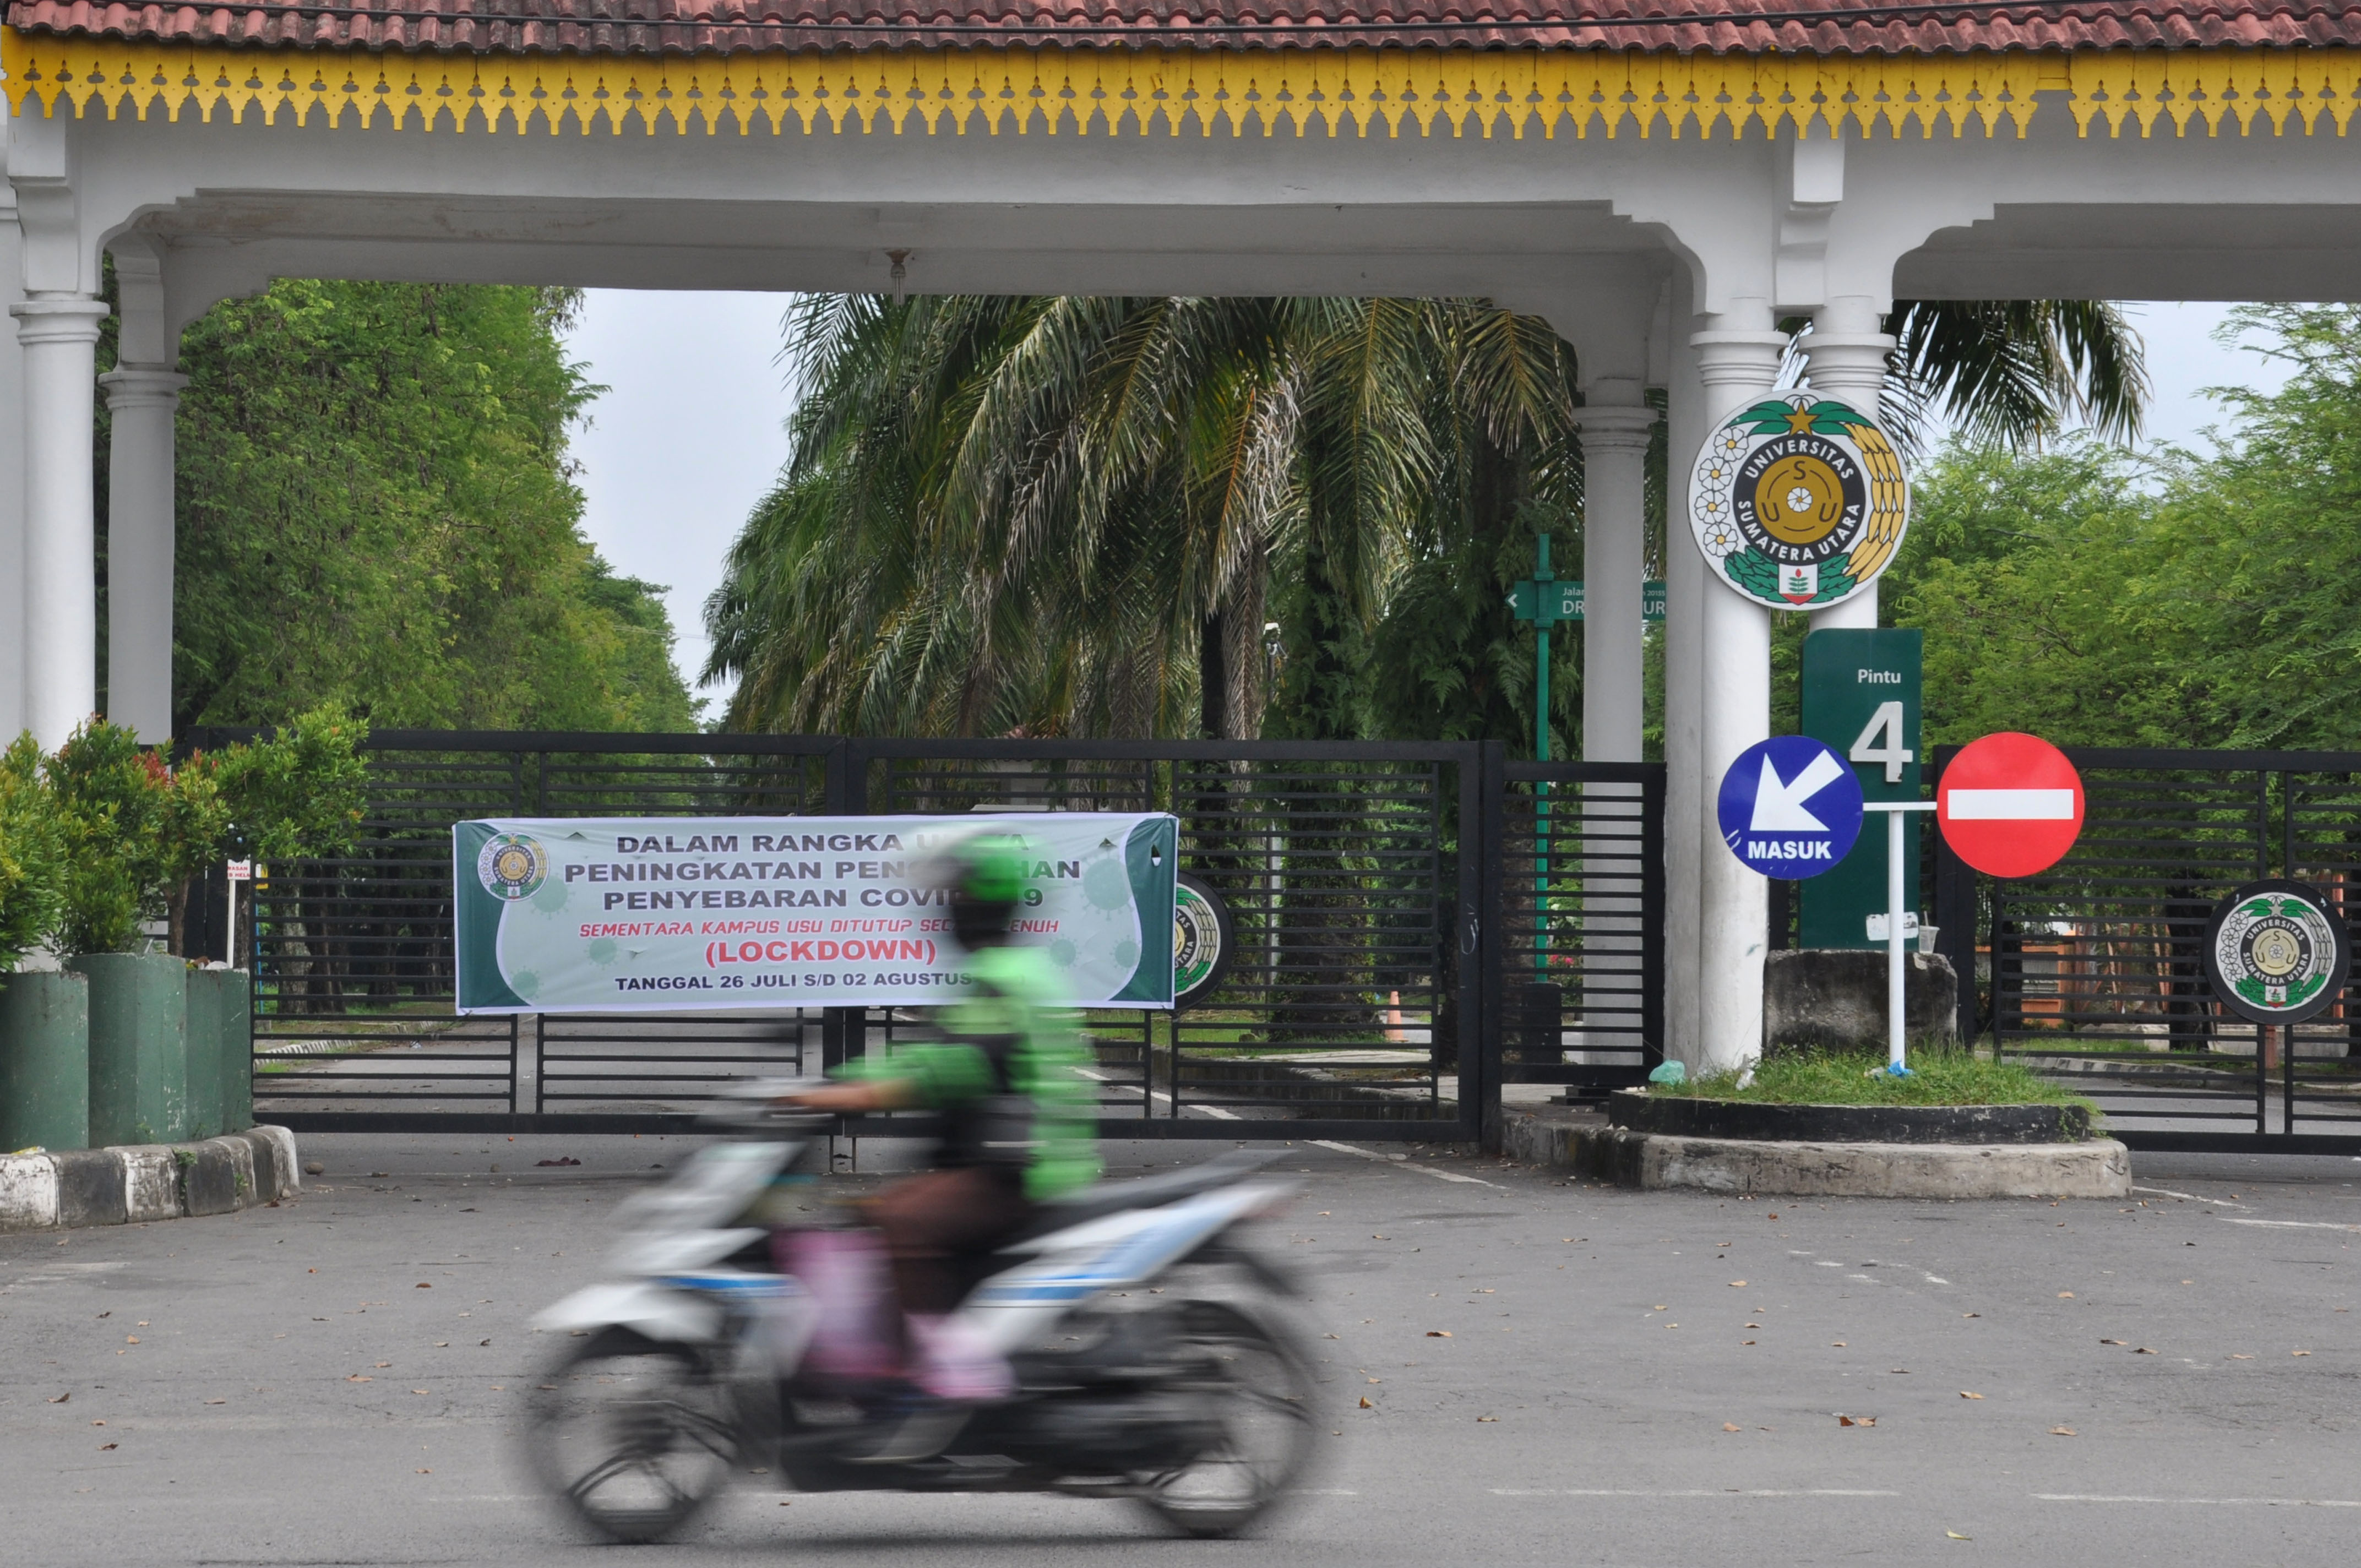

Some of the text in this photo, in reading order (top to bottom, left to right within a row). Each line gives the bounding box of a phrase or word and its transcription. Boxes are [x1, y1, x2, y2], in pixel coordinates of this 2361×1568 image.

[1745, 440, 1854, 479] UNIVERSITAS
[1793, 460, 1807, 480] S
[1761, 503, 1837, 522] U U
[1738, 500, 1860, 561] SUMATERA UTARA
[1857, 668, 1901, 684] Pintu
[1849, 701, 1913, 783] 4
[617, 835, 738, 853] DALAM
[752, 834, 904, 852] RANGKA
[1748, 841, 1832, 860] MASUK
[565, 862, 821, 882] PENINGKATAN
[604, 889, 847, 910] PENYEBARAN
[579, 921, 694, 937] SEMENTARA
[701, 920, 780, 934] KAMPUS
[787, 919, 823, 933] USU
[830, 919, 913, 933] DITUTUP
[1007, 919, 1059, 933] ENUH
[2246, 918, 2305, 941] UNIVERSITAS
[705, 939, 935, 968] (LOCKDOWN)
[2242, 952, 2309, 984] SUMATERA UTARA
[615, 977, 713, 990] TANGGAL
[720, 975, 744, 988] 26
[750, 974, 796, 987] JULI
[804, 973, 836, 987] S/D
[842, 973, 867, 986] 02
[873, 972, 972, 986] AGUSTUS
